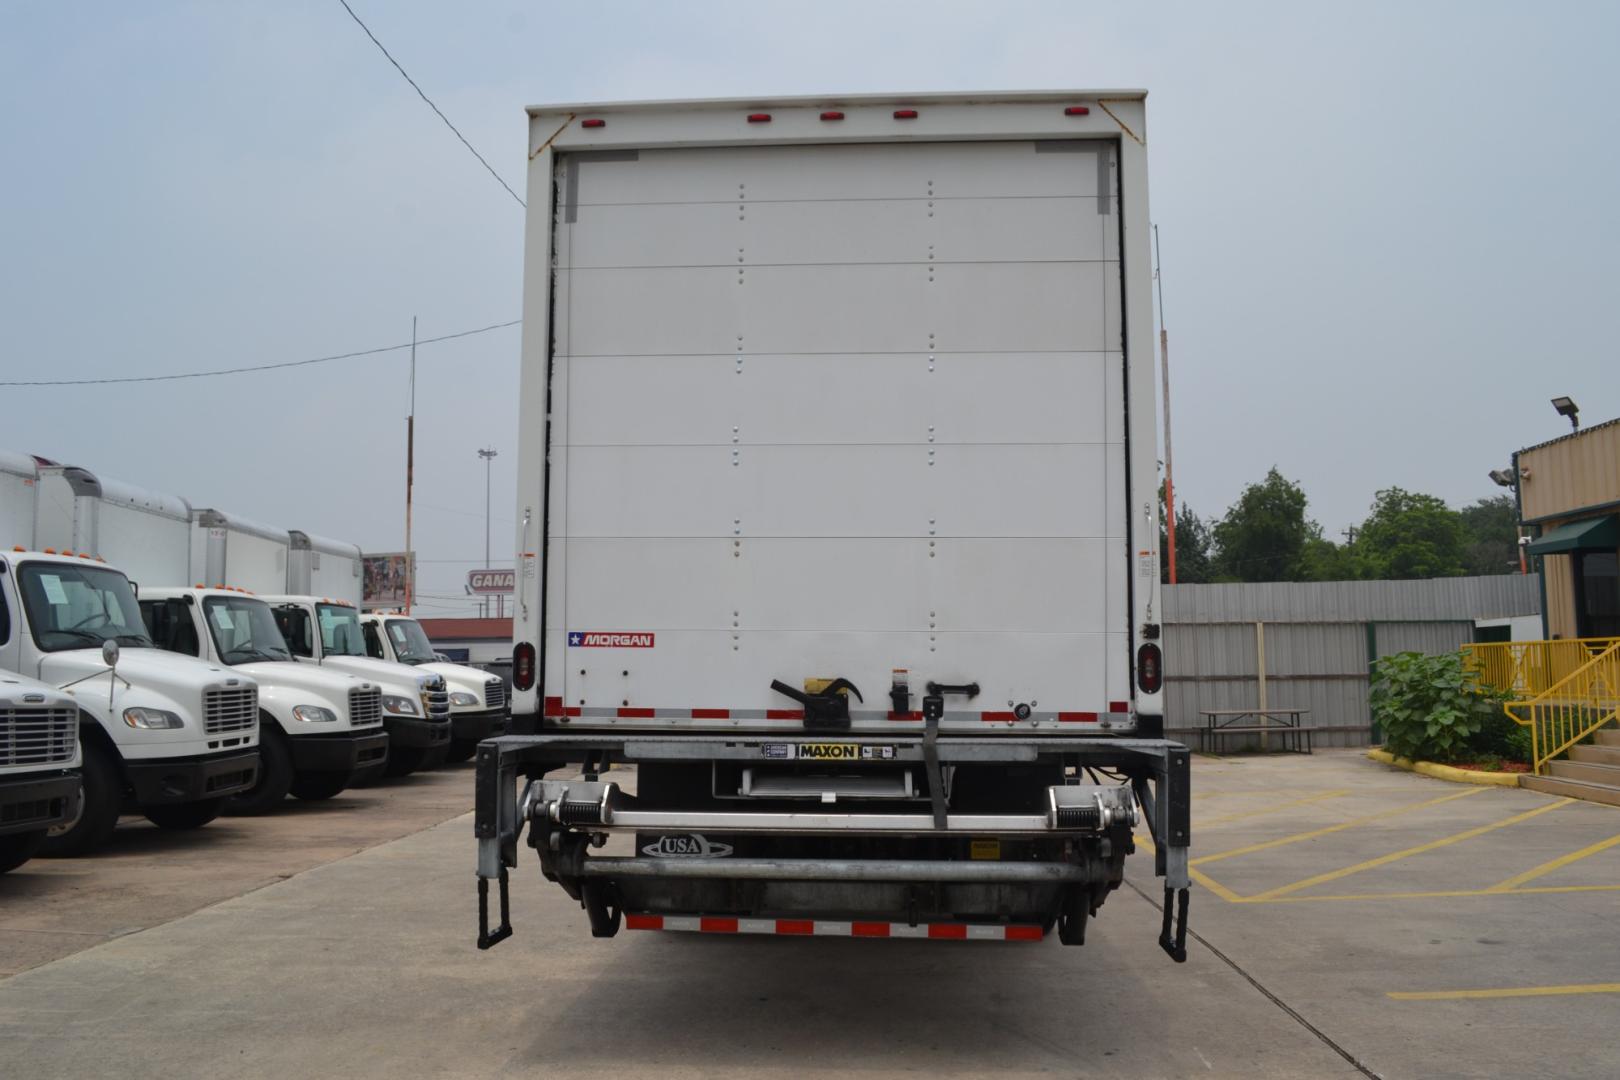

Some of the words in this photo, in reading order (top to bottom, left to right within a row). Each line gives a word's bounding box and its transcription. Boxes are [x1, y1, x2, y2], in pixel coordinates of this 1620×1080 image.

[472, 574, 514, 587] GANA
[584, 634, 651, 646] MORGAN
[801, 745, 855, 758] MAXON
[665, 838, 700, 853] USA
